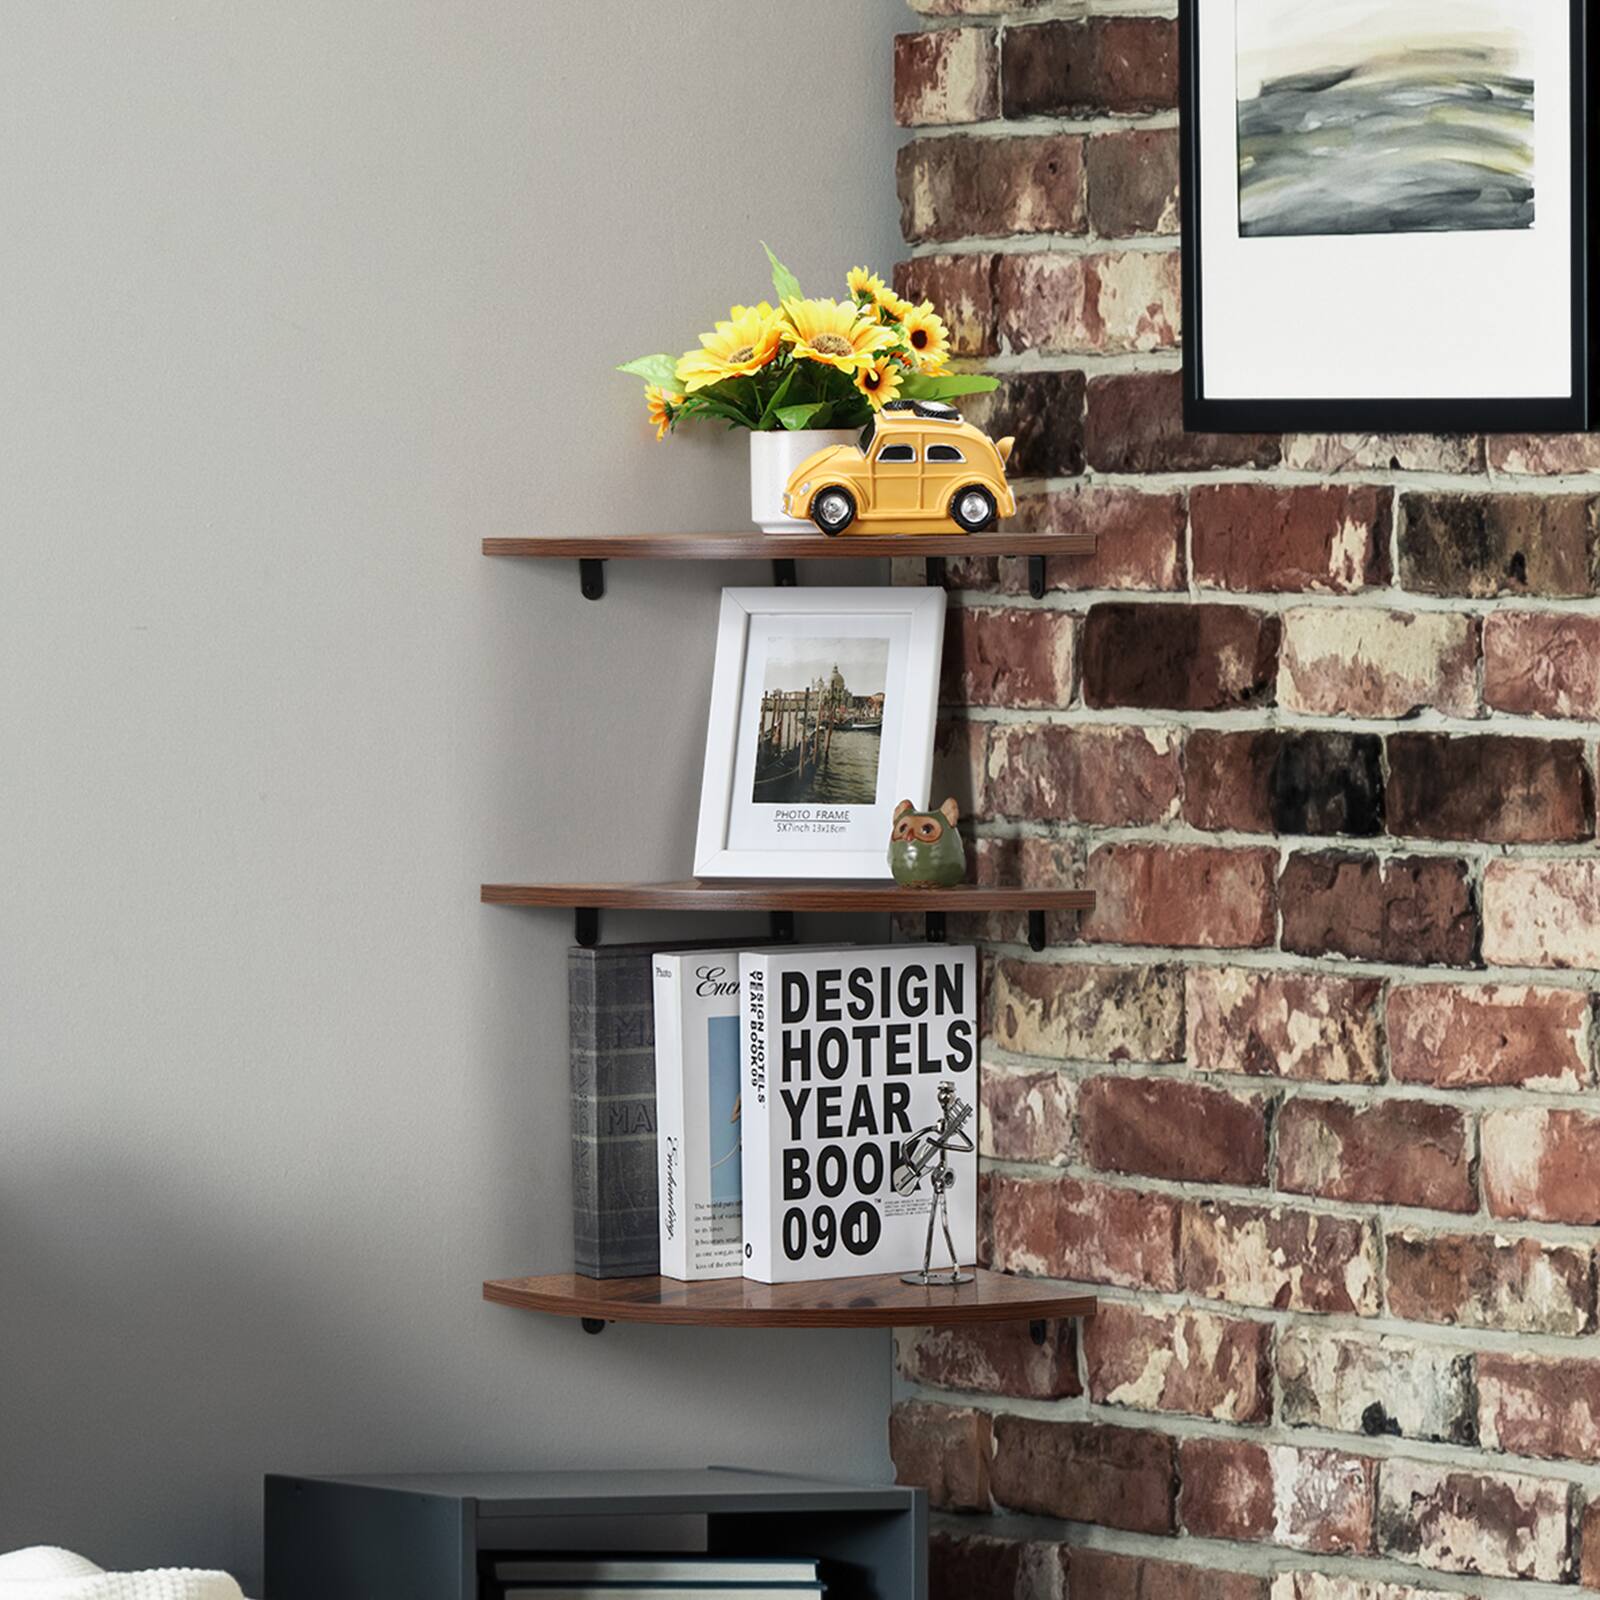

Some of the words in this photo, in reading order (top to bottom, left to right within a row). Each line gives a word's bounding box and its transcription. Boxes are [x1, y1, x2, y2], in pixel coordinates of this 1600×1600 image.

[775, 810, 811, 819] PHOTO
[815, 810, 850, 820] FRAME
[749, 970, 758, 1013] YEAR
[756, 971, 765, 1032] DESIGN
[781, 963, 964, 1025] DESIGN
[757, 1039, 766, 1103] HOTELS
[781, 1019, 973, 1082] HOTELS
[780, 1082, 913, 1140] YEAR
[782, 1205, 837, 1261] 09
